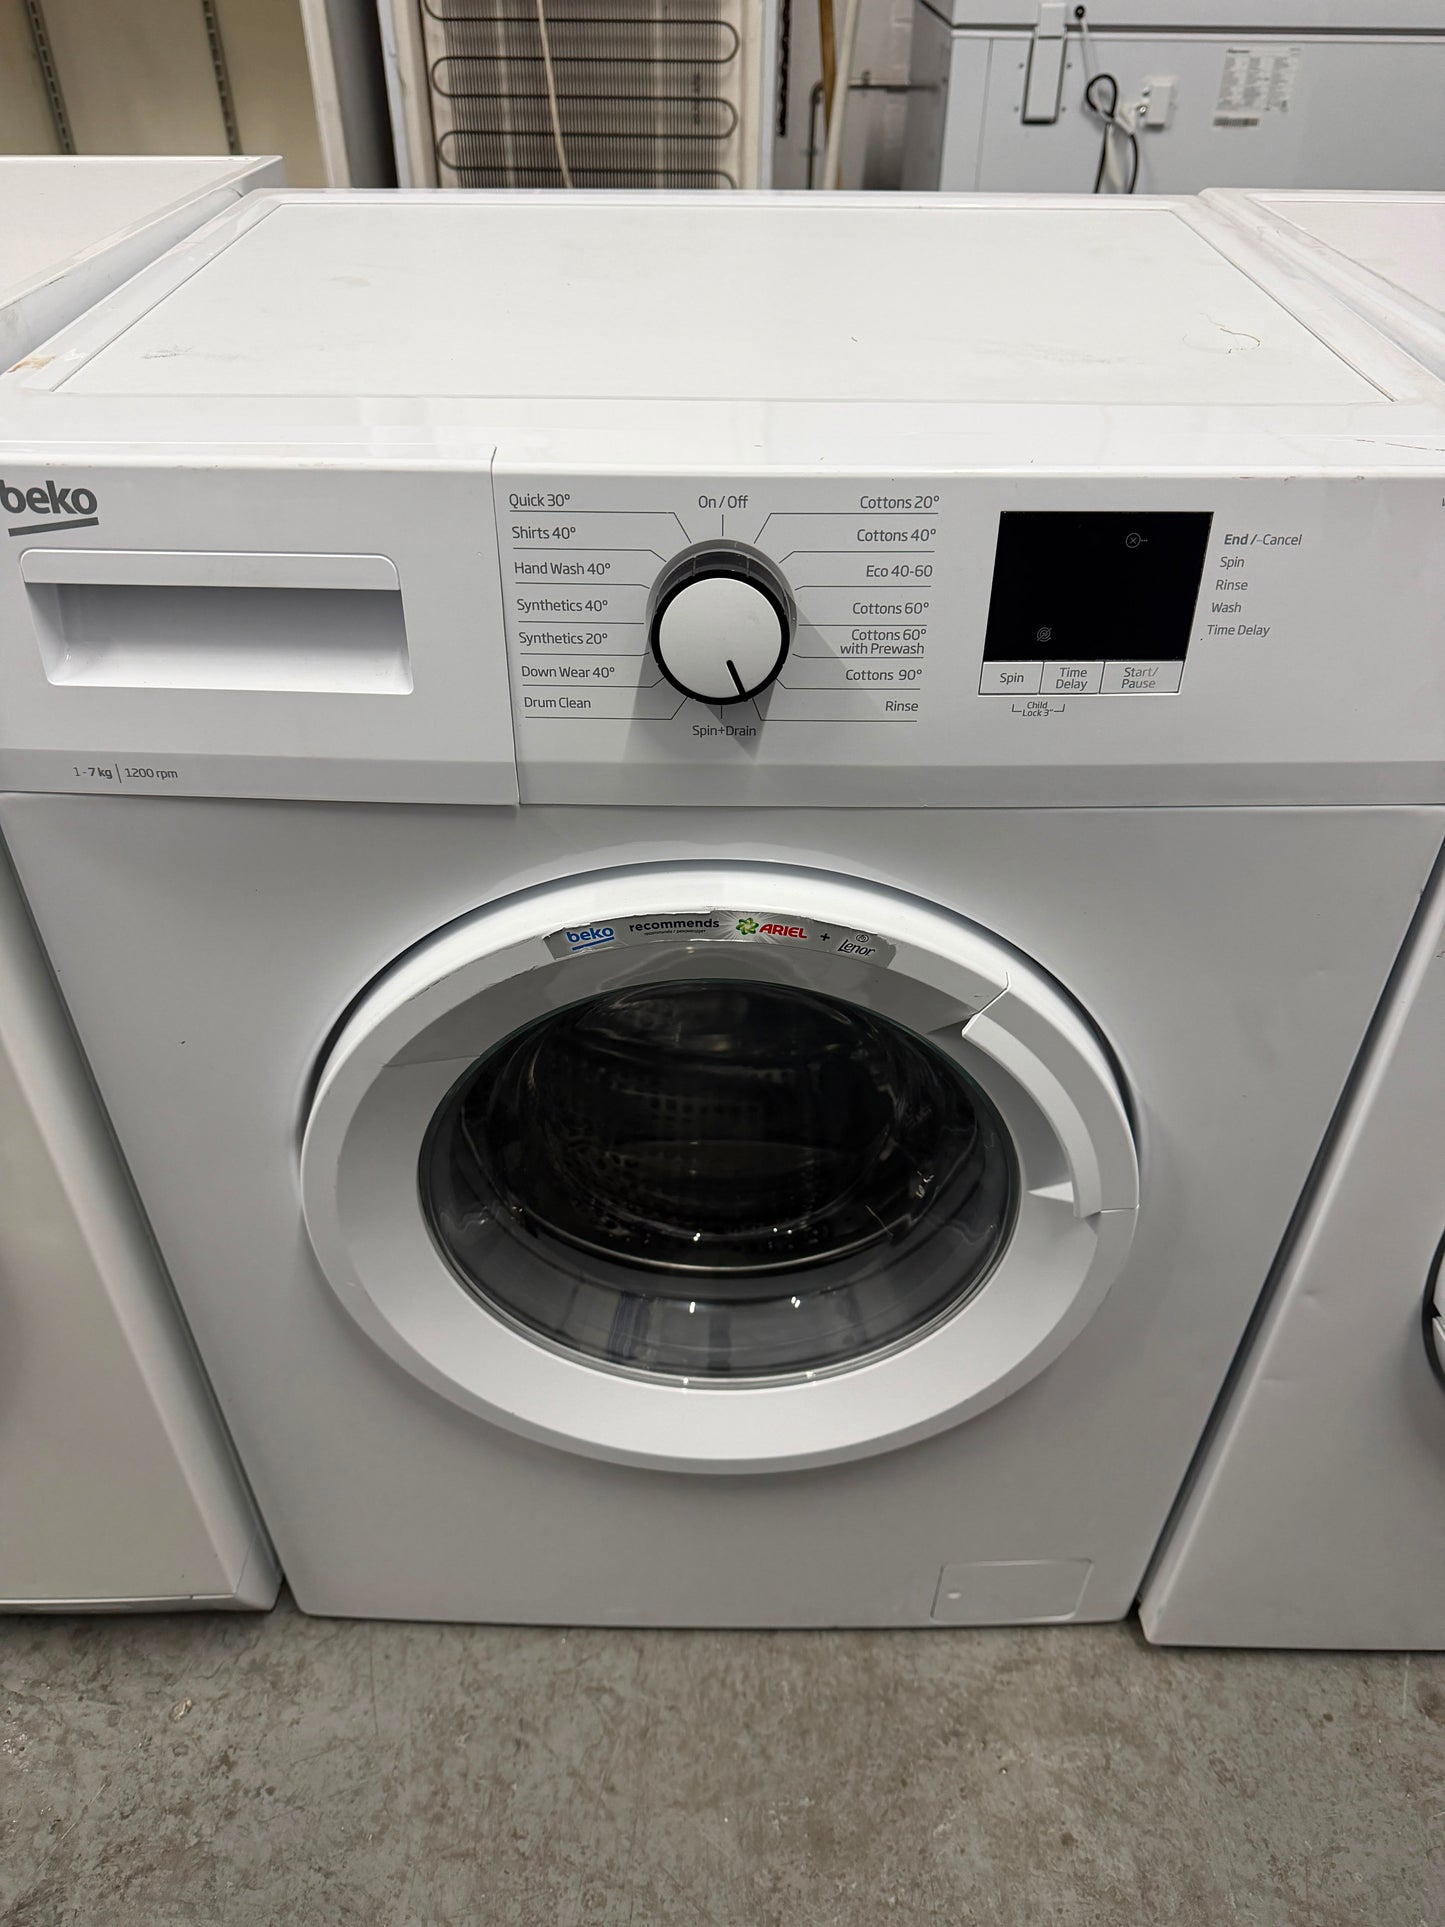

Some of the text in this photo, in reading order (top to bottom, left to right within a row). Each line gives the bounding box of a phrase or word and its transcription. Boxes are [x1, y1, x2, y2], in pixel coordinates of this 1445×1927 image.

[0, 479, 98, 515] beko
[508, 492, 545, 510] Quick
[698, 495, 717, 509] On
[727, 494, 749, 509] Off
[859, 495, 913, 509] Cottons
[511, 525, 550, 540] Shirts
[856, 528, 909, 542] Cottons
[1223, 533, 1250, 546] End
[514, 561, 548, 575] Hand
[549, 562, 585, 575] Wash
[1219, 555, 1245, 571] Spin
[865, 564, 933, 578] Eco 40-60
[1215, 578, 1249, 591] Rinse
[516, 598, 583, 614] Synthetics
[852, 602, 903, 615] Cottons
[1211, 601, 1242, 614] Wash
[851, 628, 901, 641] Cottons
[1207, 624, 1271, 639] Time Delay
[518, 631, 584, 647] Synthetics
[840, 642, 925, 655] with Prewash
[521, 665, 557, 678] Down
[558, 666, 591, 678] Wear
[845, 669, 894, 681] Cottons
[1059, 666, 1088, 678] Time
[999, 672, 1025, 686] Spin
[1055, 678, 1088, 692] Delay
[1121, 678, 1156, 689] Pause
[523, 696, 592, 709] Drum Clean
[885, 700, 919, 712] Rinse
[1026, 701, 1049, 709] Child
[1022, 709, 1042, 717] Lock
[124, 767, 155, 778] 1200
[155, 770, 179, 781] rpm
[565, 927, 614, 943] beko
[629, 918, 720, 932] recommends
[759, 924, 808, 939] ARIEL
[837, 939, 876, 957] Lenor
